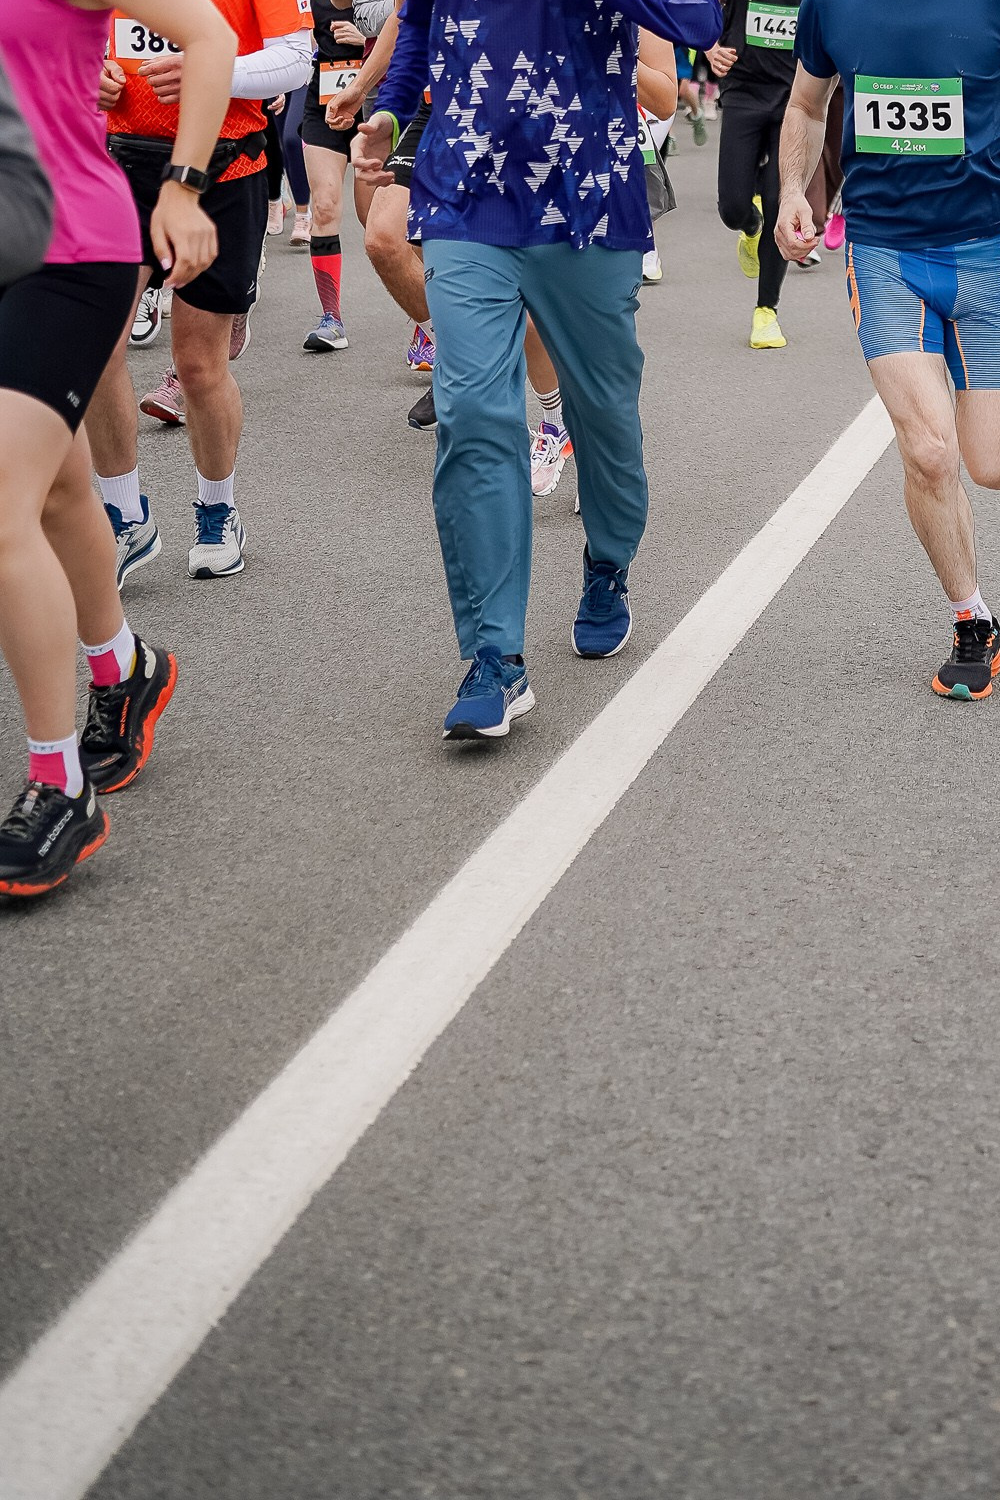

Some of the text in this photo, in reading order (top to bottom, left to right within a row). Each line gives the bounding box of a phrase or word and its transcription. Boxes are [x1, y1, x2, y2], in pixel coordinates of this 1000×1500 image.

[753, 16, 798, 36] 1443
[866, 100, 952, 132] 1335
[38, 808, 74, 858] new balance
